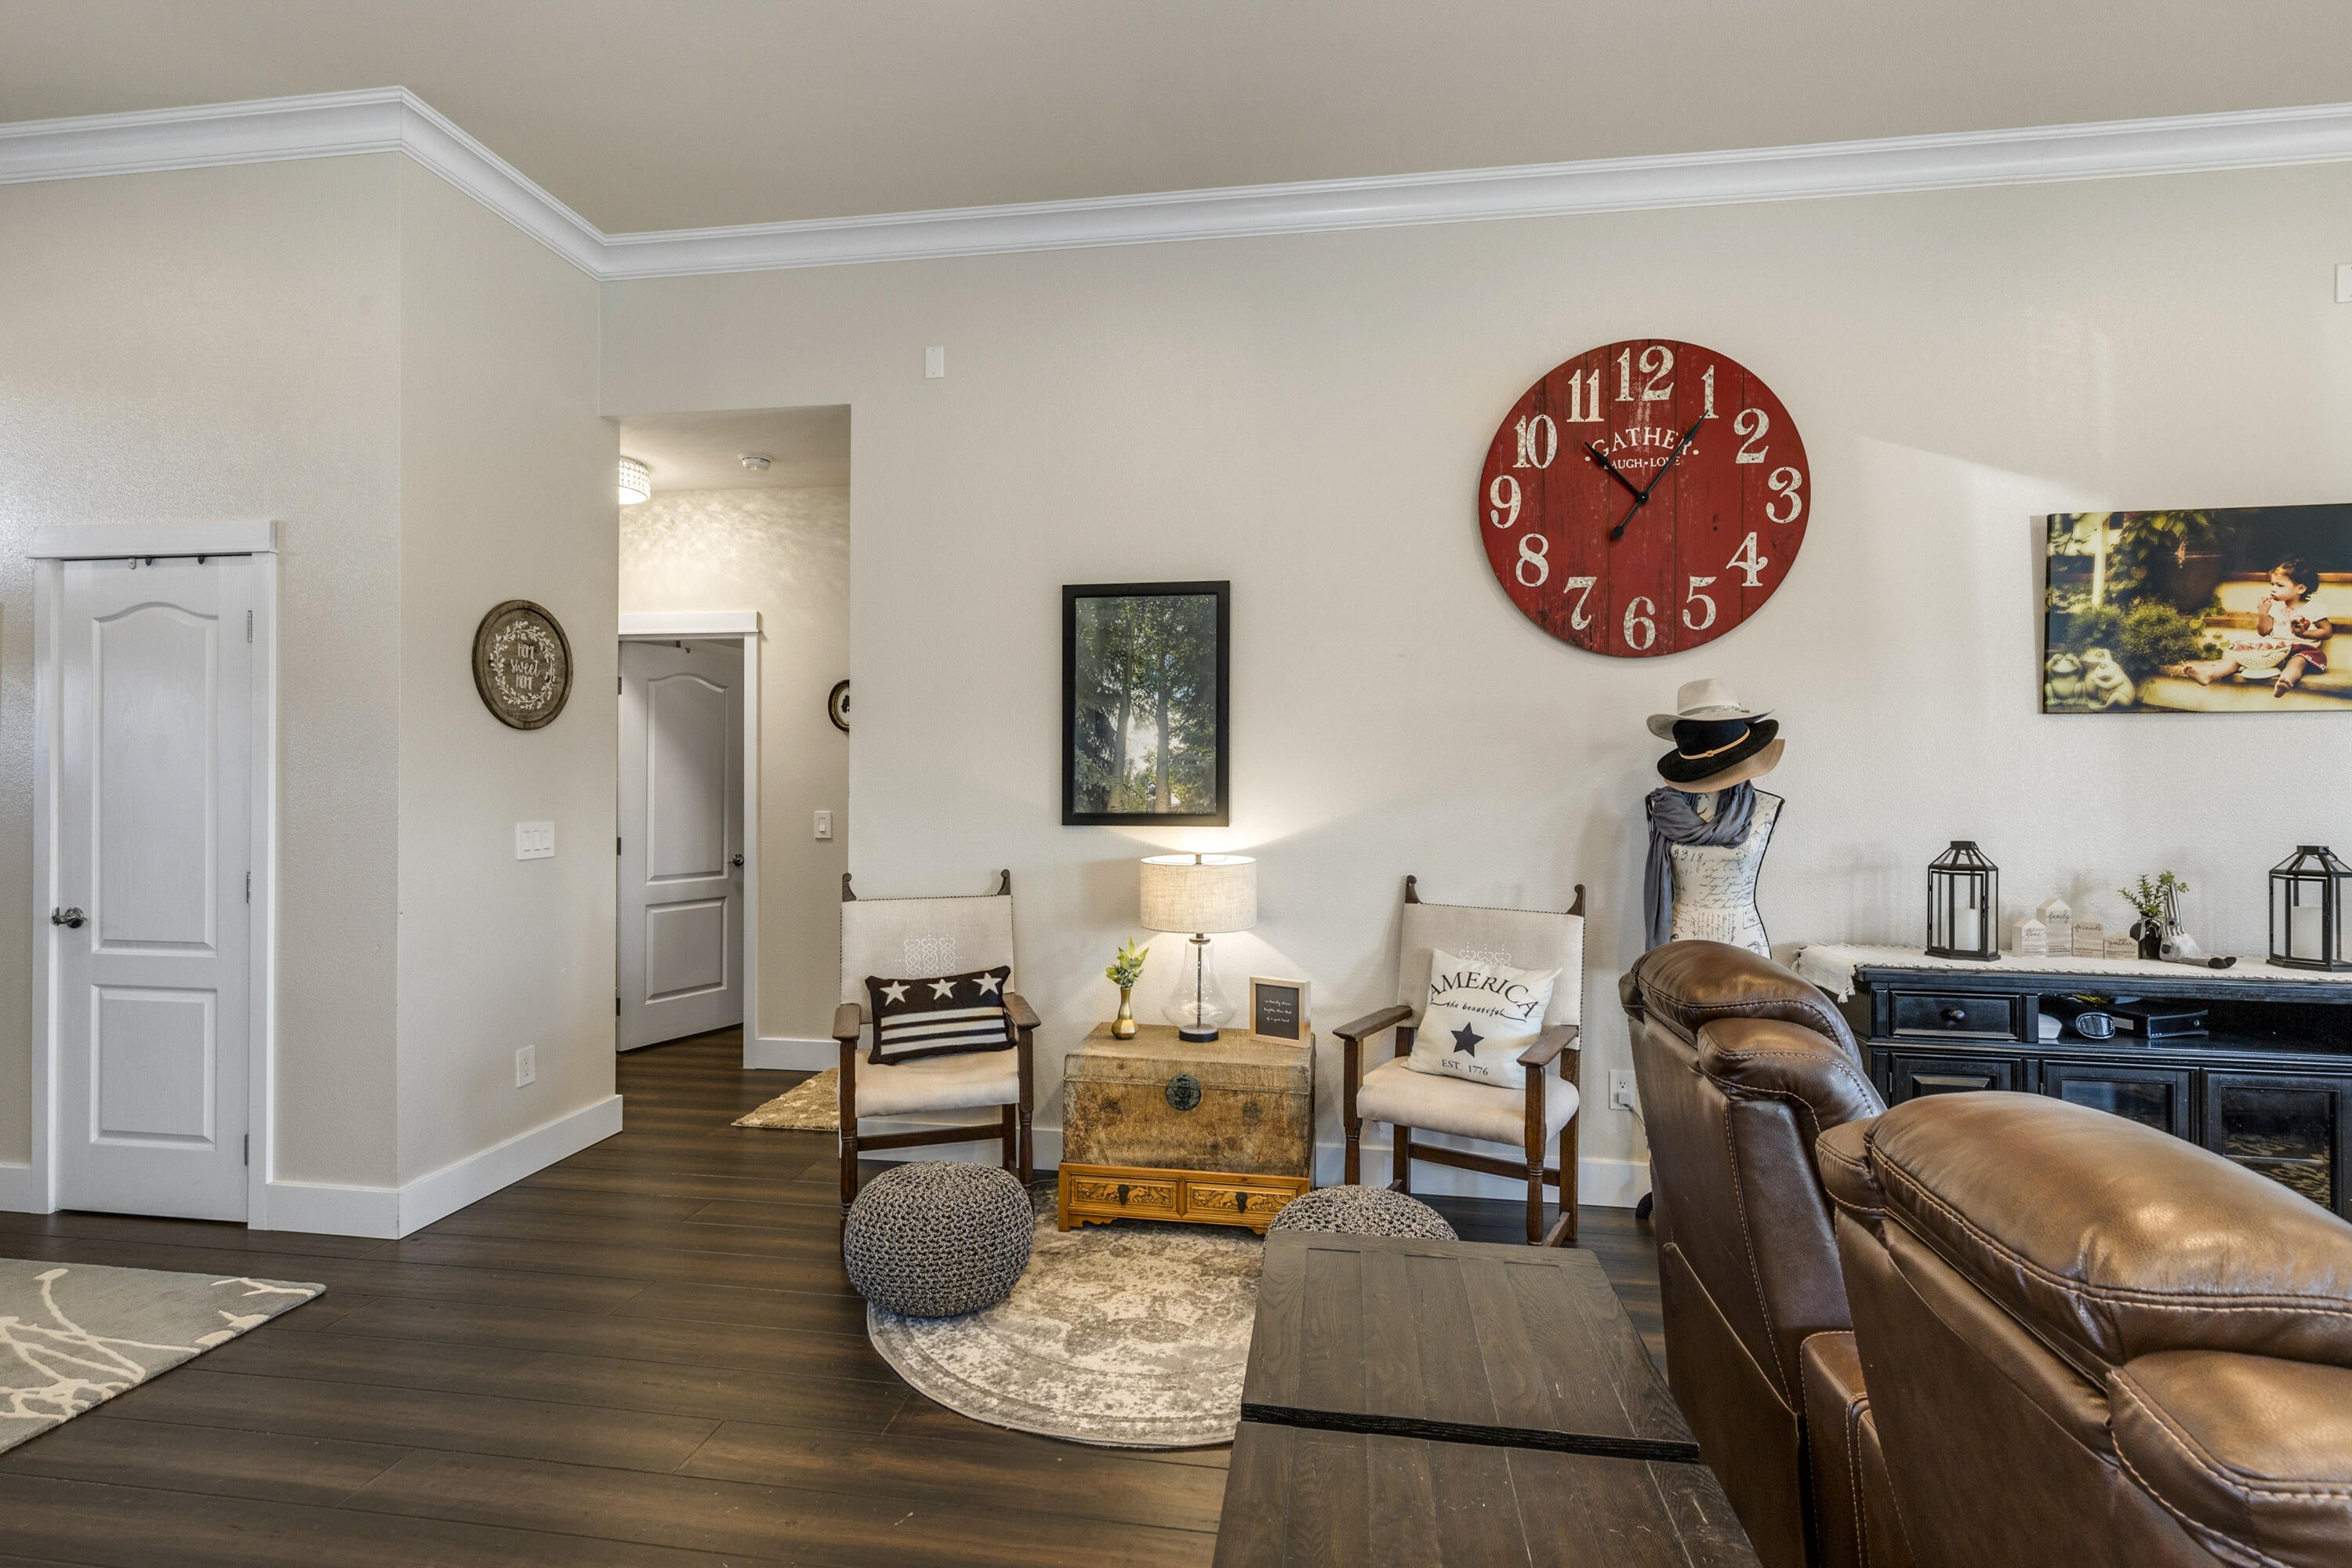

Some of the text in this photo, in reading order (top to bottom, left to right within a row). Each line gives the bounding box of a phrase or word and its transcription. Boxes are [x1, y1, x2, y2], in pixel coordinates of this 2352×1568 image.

[1566, 368, 1605, 423] 11
[1615, 345, 1674, 401] 12
[1700, 365, 1719, 419] 1
[1512, 414, 1558, 469] 10
[1650, 456, 1680, 468] LOE
[1733, 408, 1769, 464] 2
[1490, 475, 1522, 528] 9
[1766, 466, 1802, 524] 3
[1515, 533, 1549, 587] 8
[1726, 532, 1768, 586] 4
[1563, 576, 1597, 630] 7
[1623, 596, 1656, 650] 6
[1682, 576, 1717, 630] 5
[2048, 909, 2071, 923] family
[1432, 971, 1539, 1018] AMERICA
[1441, 1000, 1458, 1008] the
[1442, 1059, 1489, 1076] EST. 1776
